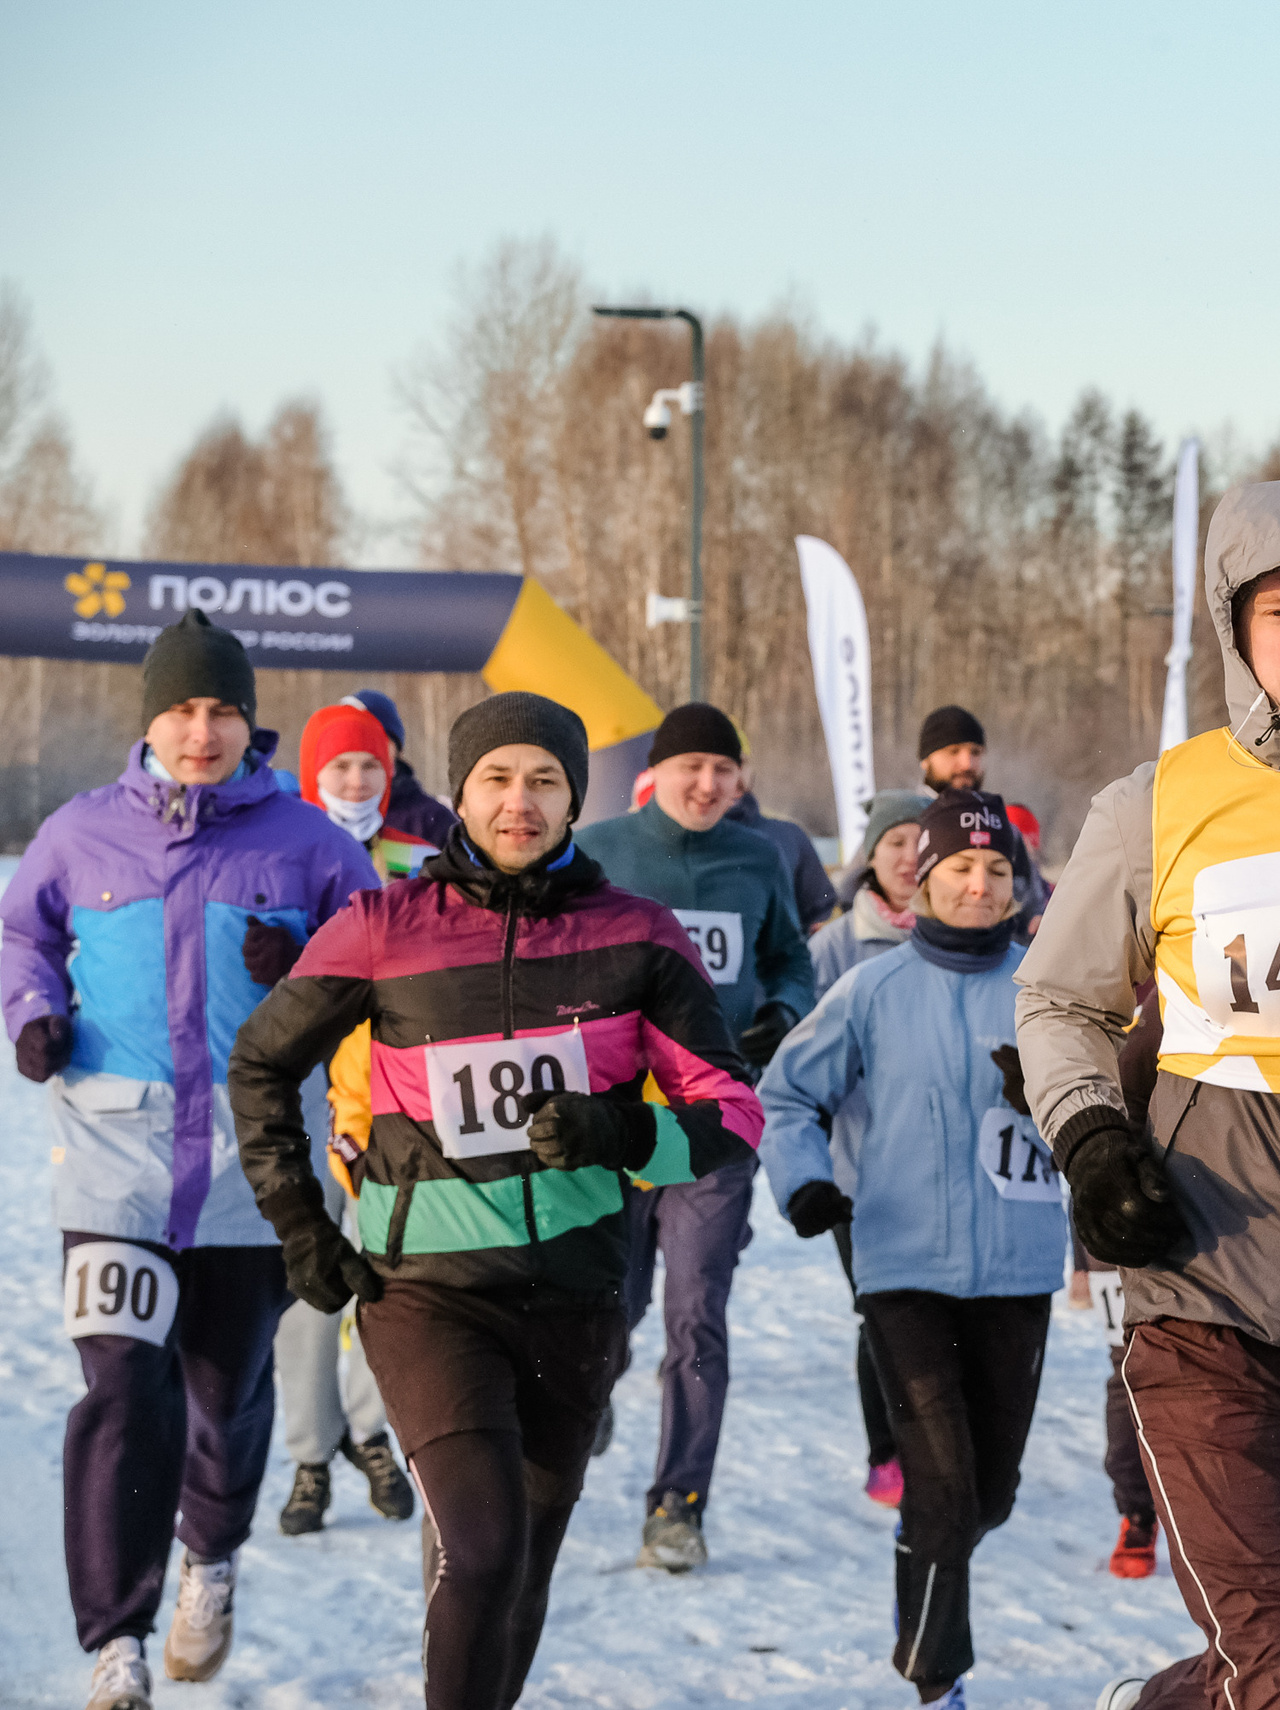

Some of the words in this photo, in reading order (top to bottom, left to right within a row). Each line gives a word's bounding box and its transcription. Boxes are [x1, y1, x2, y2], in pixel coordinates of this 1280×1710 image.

[149, 574, 351, 618] ПОЛЮС
[453, 1053, 566, 1135] 180
[75, 1261, 159, 1321] 190
